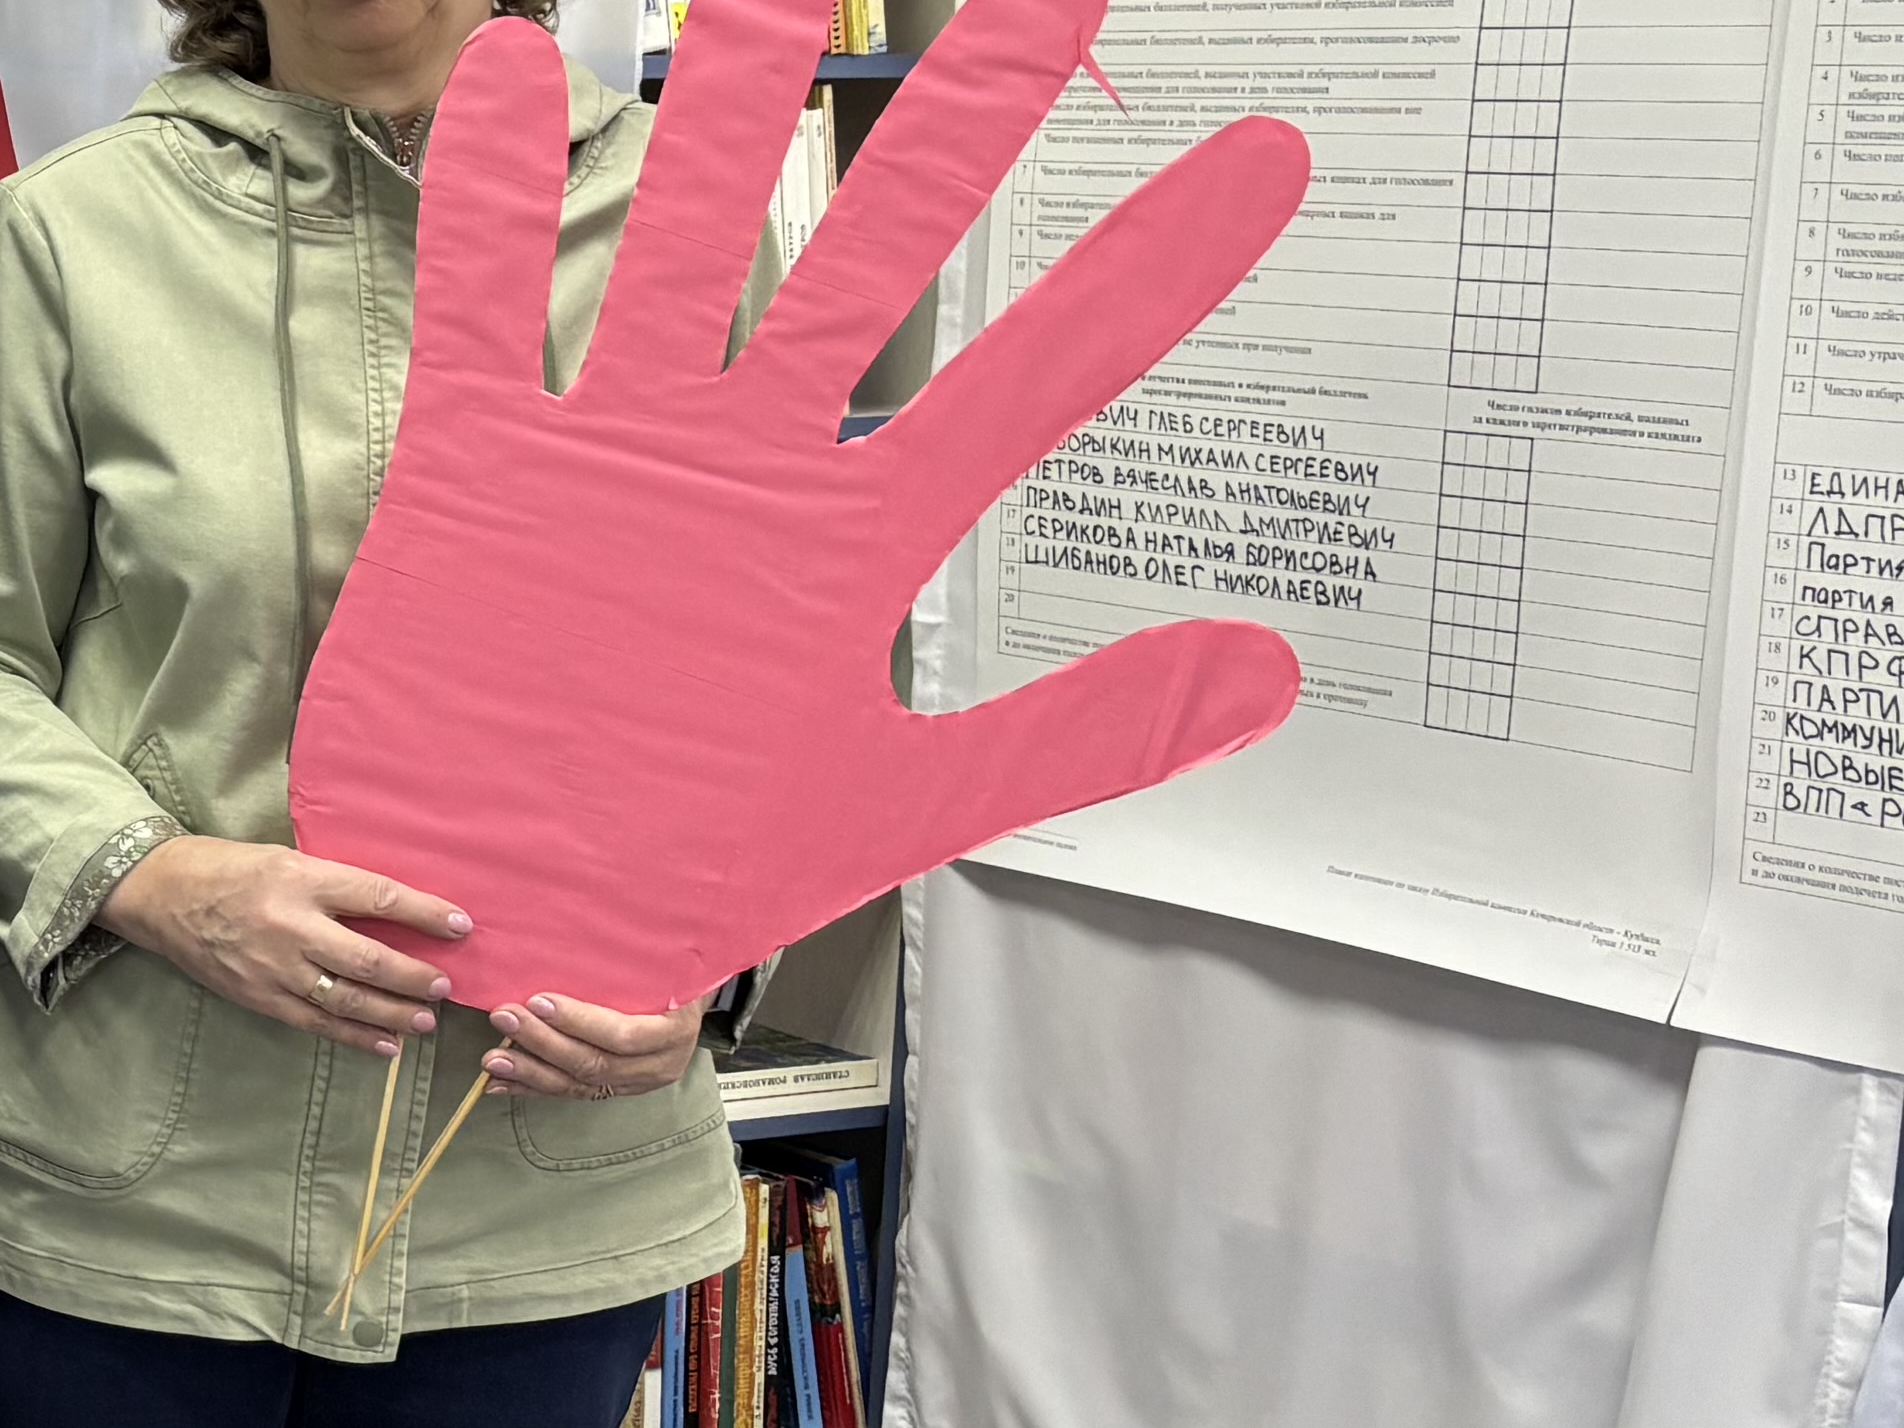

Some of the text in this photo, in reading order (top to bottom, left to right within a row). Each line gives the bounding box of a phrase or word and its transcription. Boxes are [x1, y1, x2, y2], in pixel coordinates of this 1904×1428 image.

[1148, 410, 1193, 433] ГЛЕБ
[1200, 418, 1324, 450] СЕРГЕЕВИЧ
[1158, 443, 1379, 487] МИХАИЛ СЕРГЕЕВИЧ
[1782, 469, 1796, 482] 13
[1114, 466, 1215, 499] ВЯЧЕСЛАВ
[1225, 481, 1371, 517] АНАТОЛЬЕВИЧ
[1780, 503, 1793, 516] 14
[1025, 485, 1394, 549] ПРАВДИН КИРИЛЛ ДМИТРИЕВИЧ
[1023, 515, 1377, 581] СЕРИКОВА НАТАЛЬЯ БОРИСОВНА
[1775, 537, 1790, 550] 15
[1024, 544, 1362, 610] ШИБАНОВ ОЛЕГ НИКОЛАЕВИЧ
[1772, 572, 1787, 585] 16
[1802, 584, 1894, 613] партия
